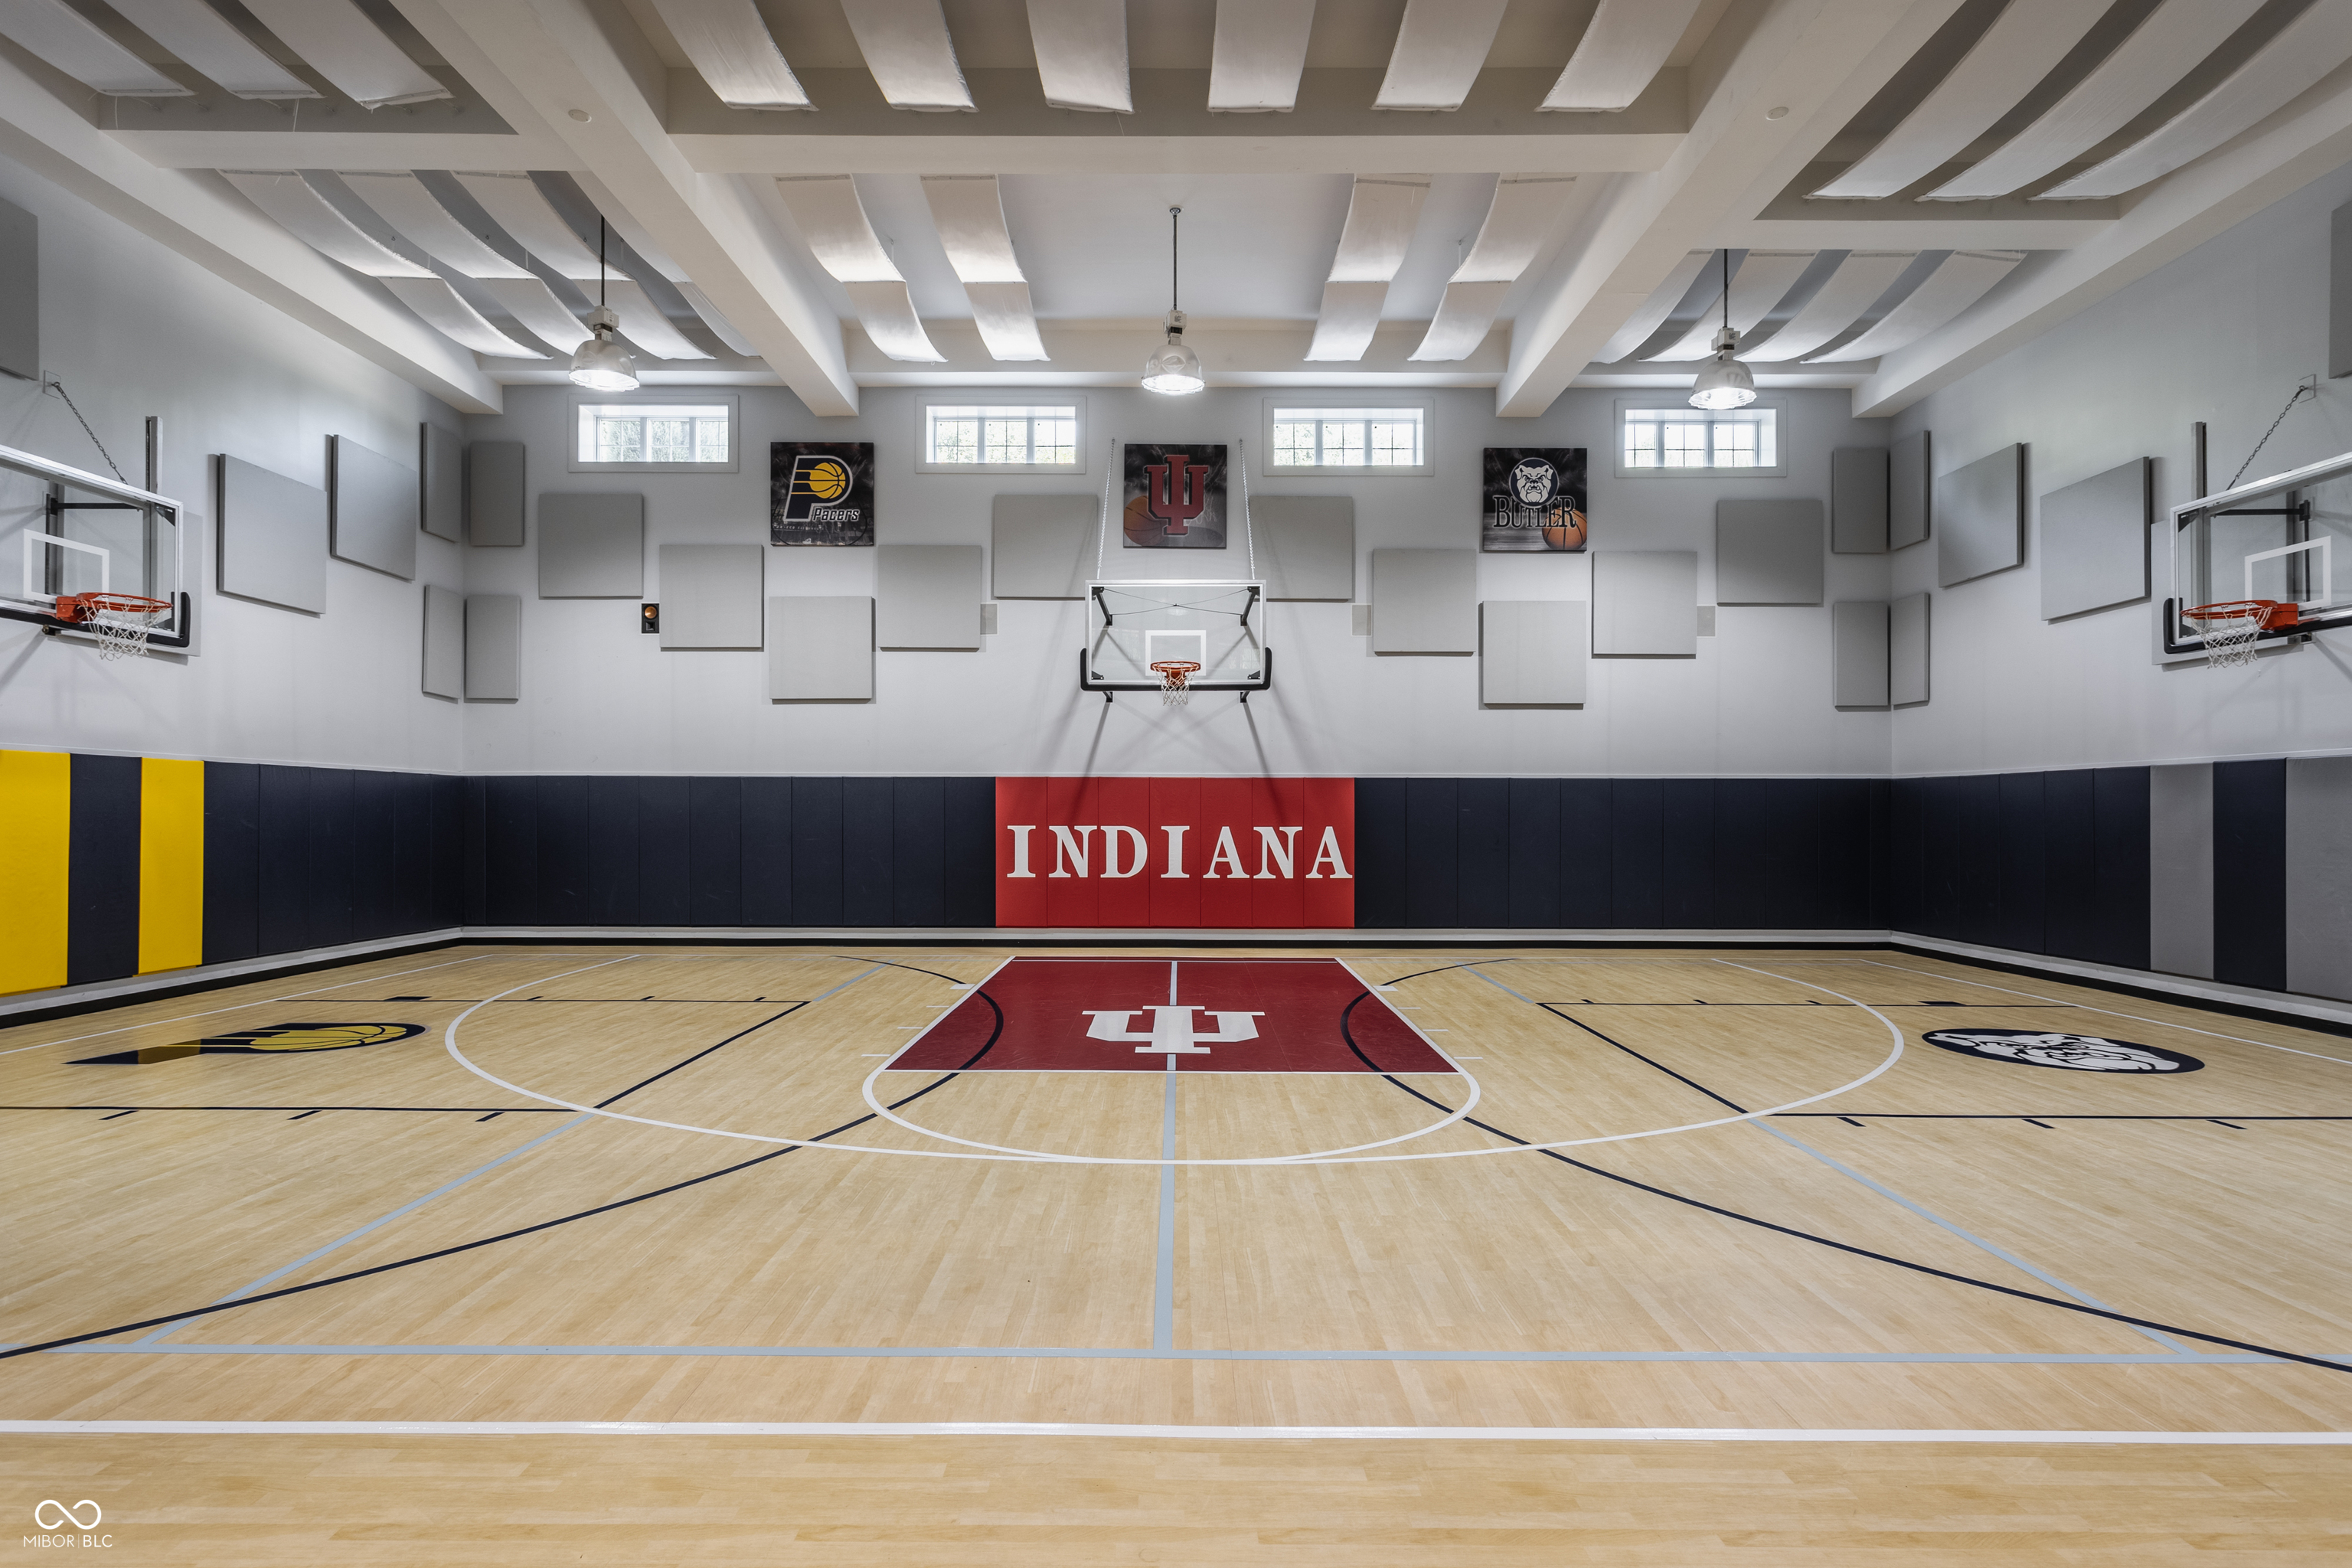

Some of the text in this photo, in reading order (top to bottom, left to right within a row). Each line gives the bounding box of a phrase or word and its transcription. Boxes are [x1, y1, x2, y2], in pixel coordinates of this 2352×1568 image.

[812, 507, 860, 521] Pacers
[1492, 495, 1576, 528] BUTLER
[1007, 825, 1353, 879] INDIANA
